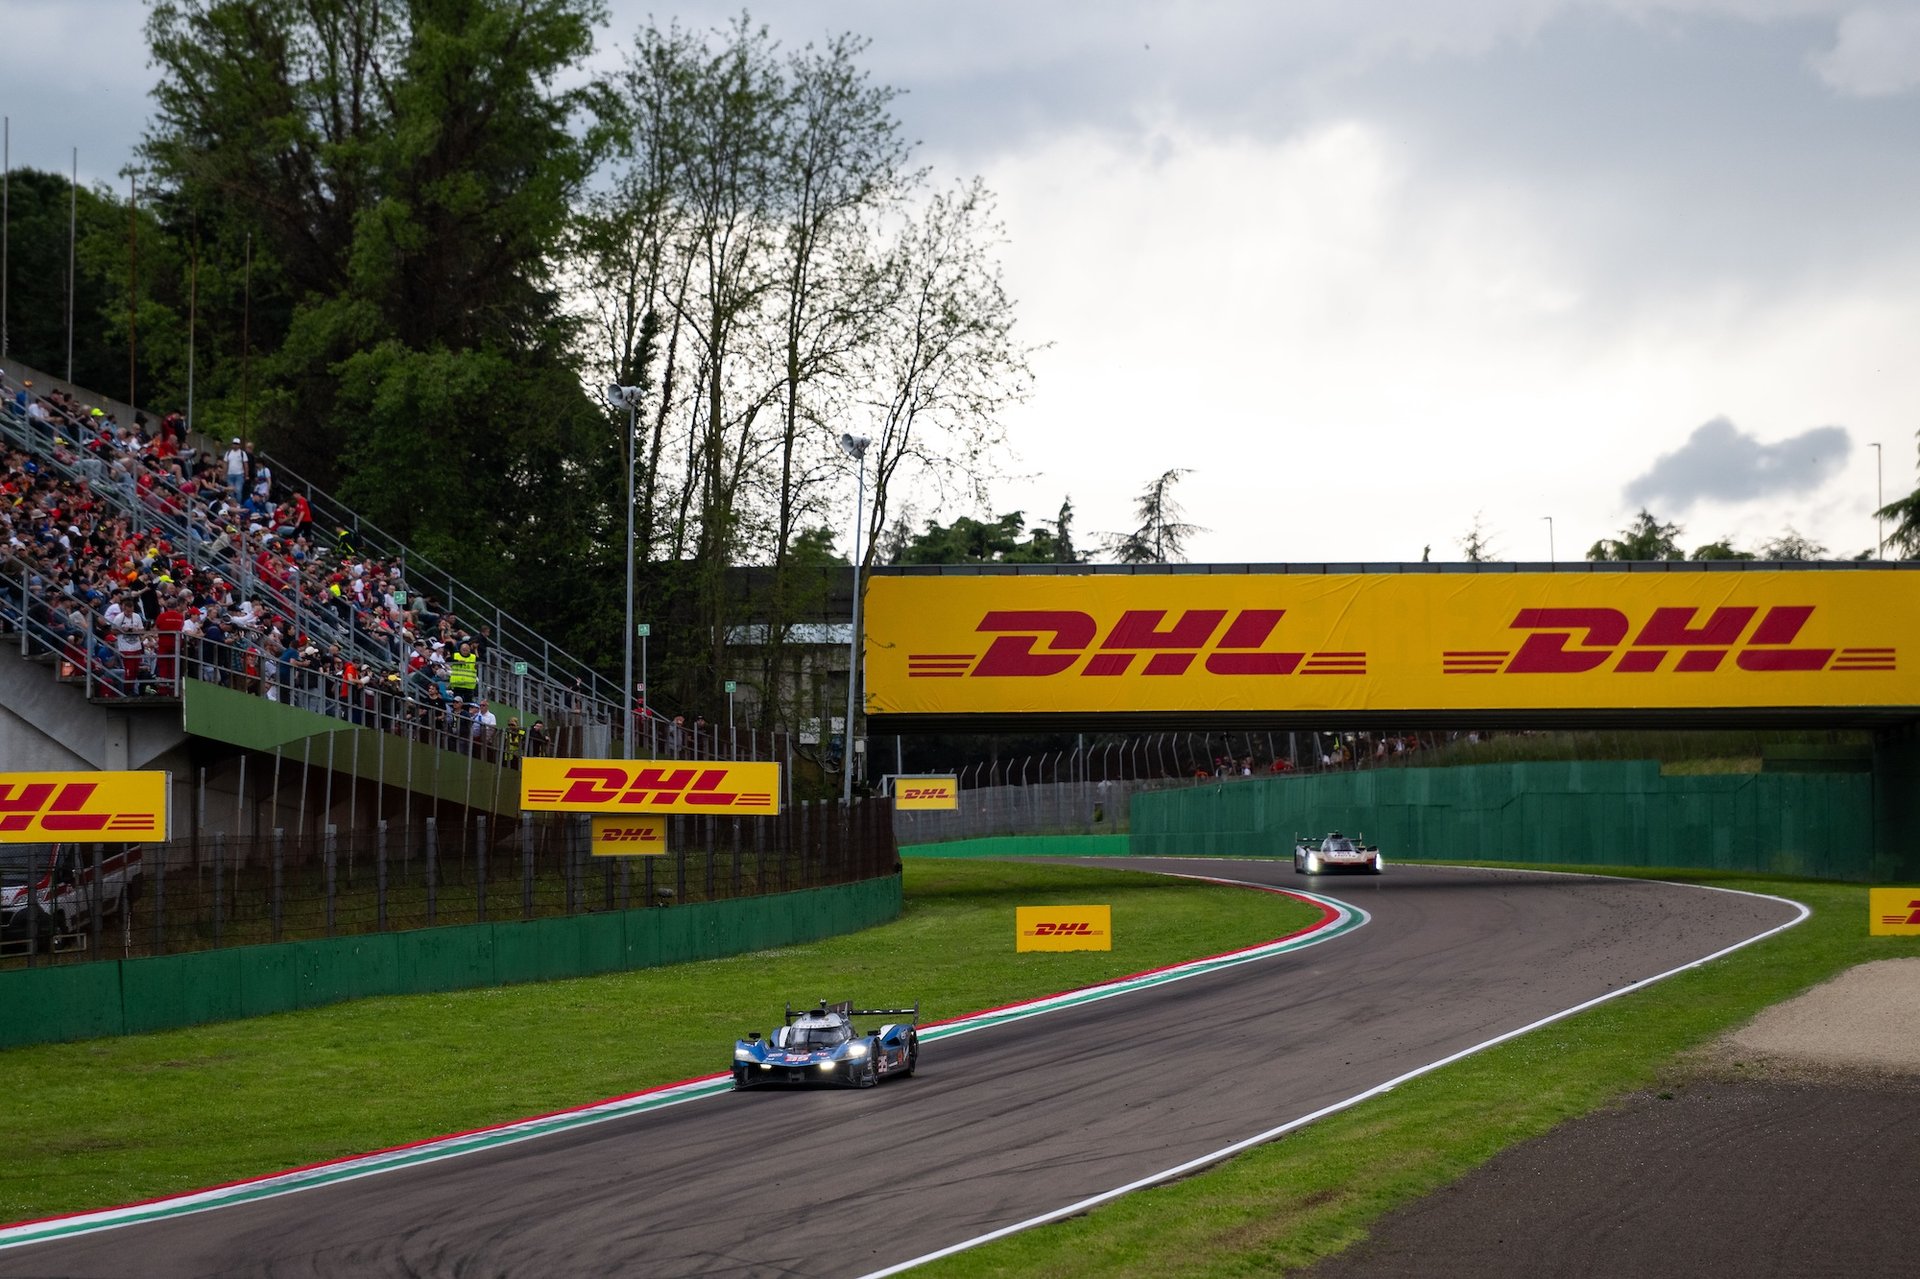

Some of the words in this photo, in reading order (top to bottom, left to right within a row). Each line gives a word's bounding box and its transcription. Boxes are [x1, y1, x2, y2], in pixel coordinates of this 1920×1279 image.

[970, 609, 1306, 677] DHL
[1503, 606, 1836, 673] DHL
[560, 767, 738, 805] DHL
[904, 788, 951, 800] DHL
[601, 828, 657, 841] DHL
[1035, 923, 1093, 936] DHL
